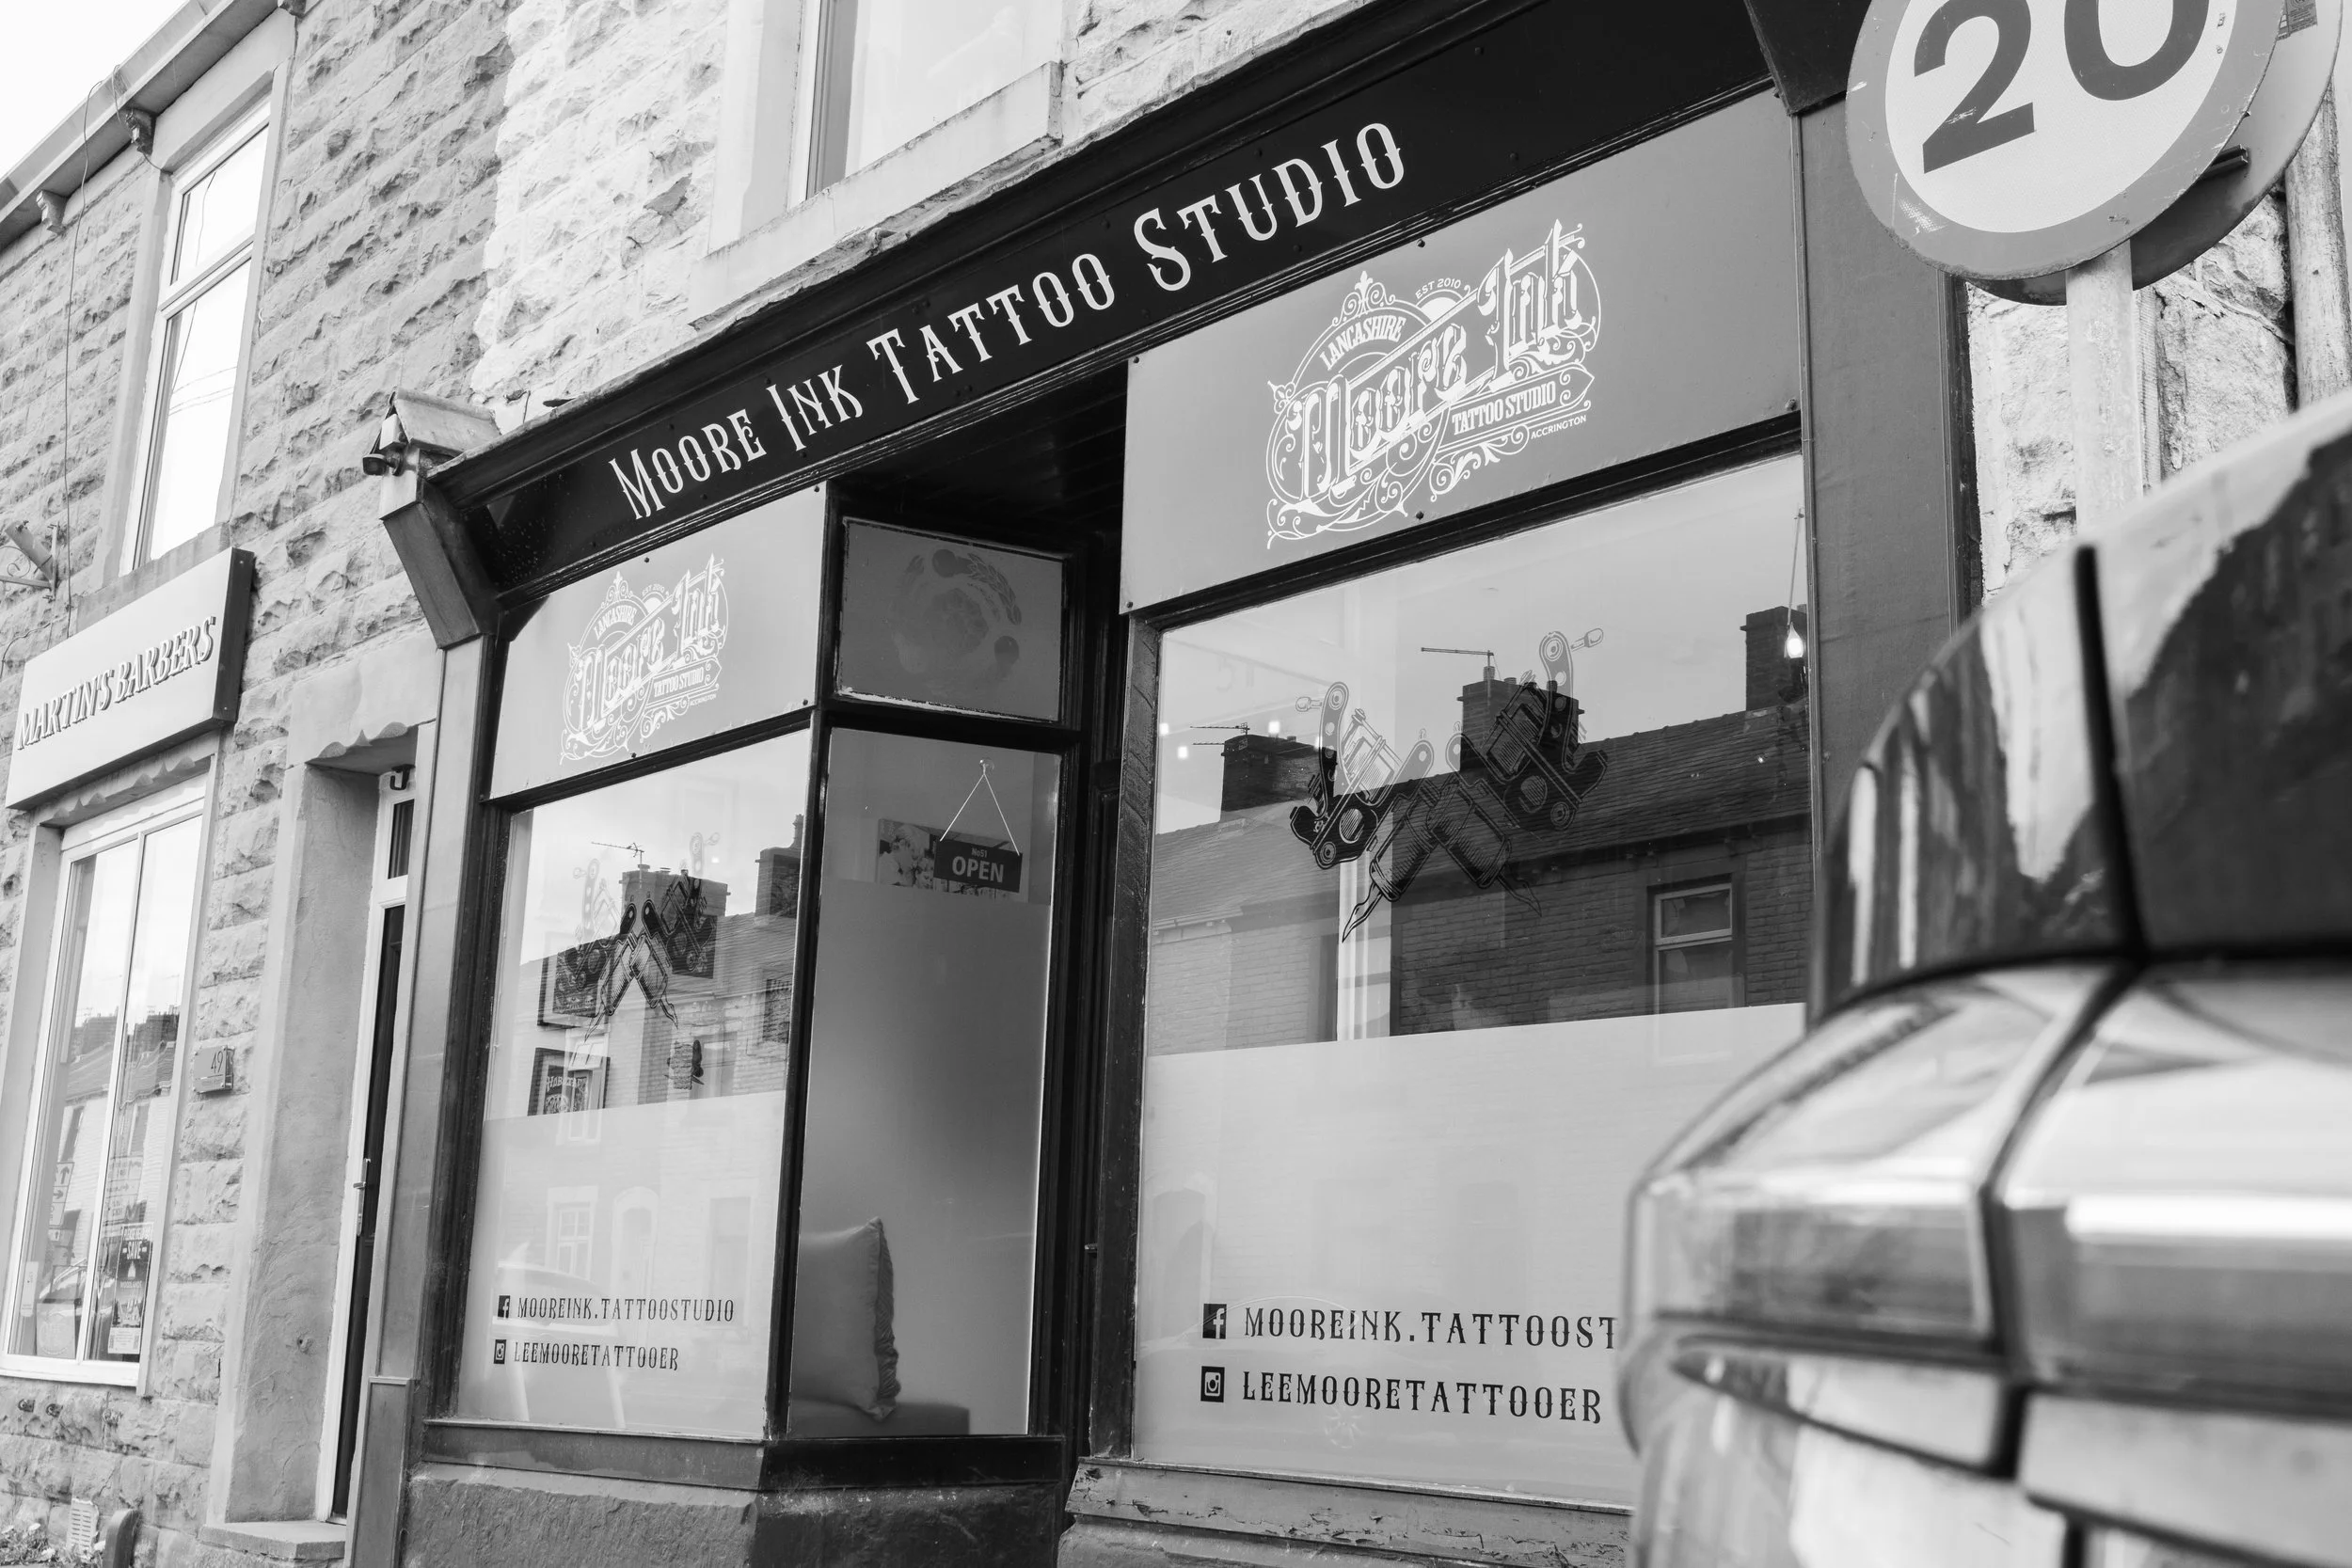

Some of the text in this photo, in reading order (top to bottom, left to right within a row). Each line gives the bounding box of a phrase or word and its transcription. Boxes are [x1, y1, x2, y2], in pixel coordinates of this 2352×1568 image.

[1914, 0, 2209, 174] 20
[1415, 277, 1462, 299] EST 2010
[608, 121, 1408, 521] MOORE INK TATTOO STUDIO
[1319, 314, 1406, 371] LANCASHIRE
[1452, 381, 1557, 436] TATTOO STUDIO
[1530, 415, 1588, 439] ACCRINGTON
[593, 604, 637, 641] LANCASHIRE
[654, 674, 679, 698] TATTOO
[17, 669, 115, 751] MARTIN'S
[951, 855, 1004, 883] OPEN
[211, 1051, 224, 1073] 49
[516, 1297, 735, 1322] MOOREINK.TATTOOSTUDIO
[1244, 1307, 1618, 1350] MOOREINK.TATTOOST
[514, 1341, 679, 1371] LEEMOORETATTOOER
[1242, 1370, 1601, 1424] LEEMOORETATTOOER
